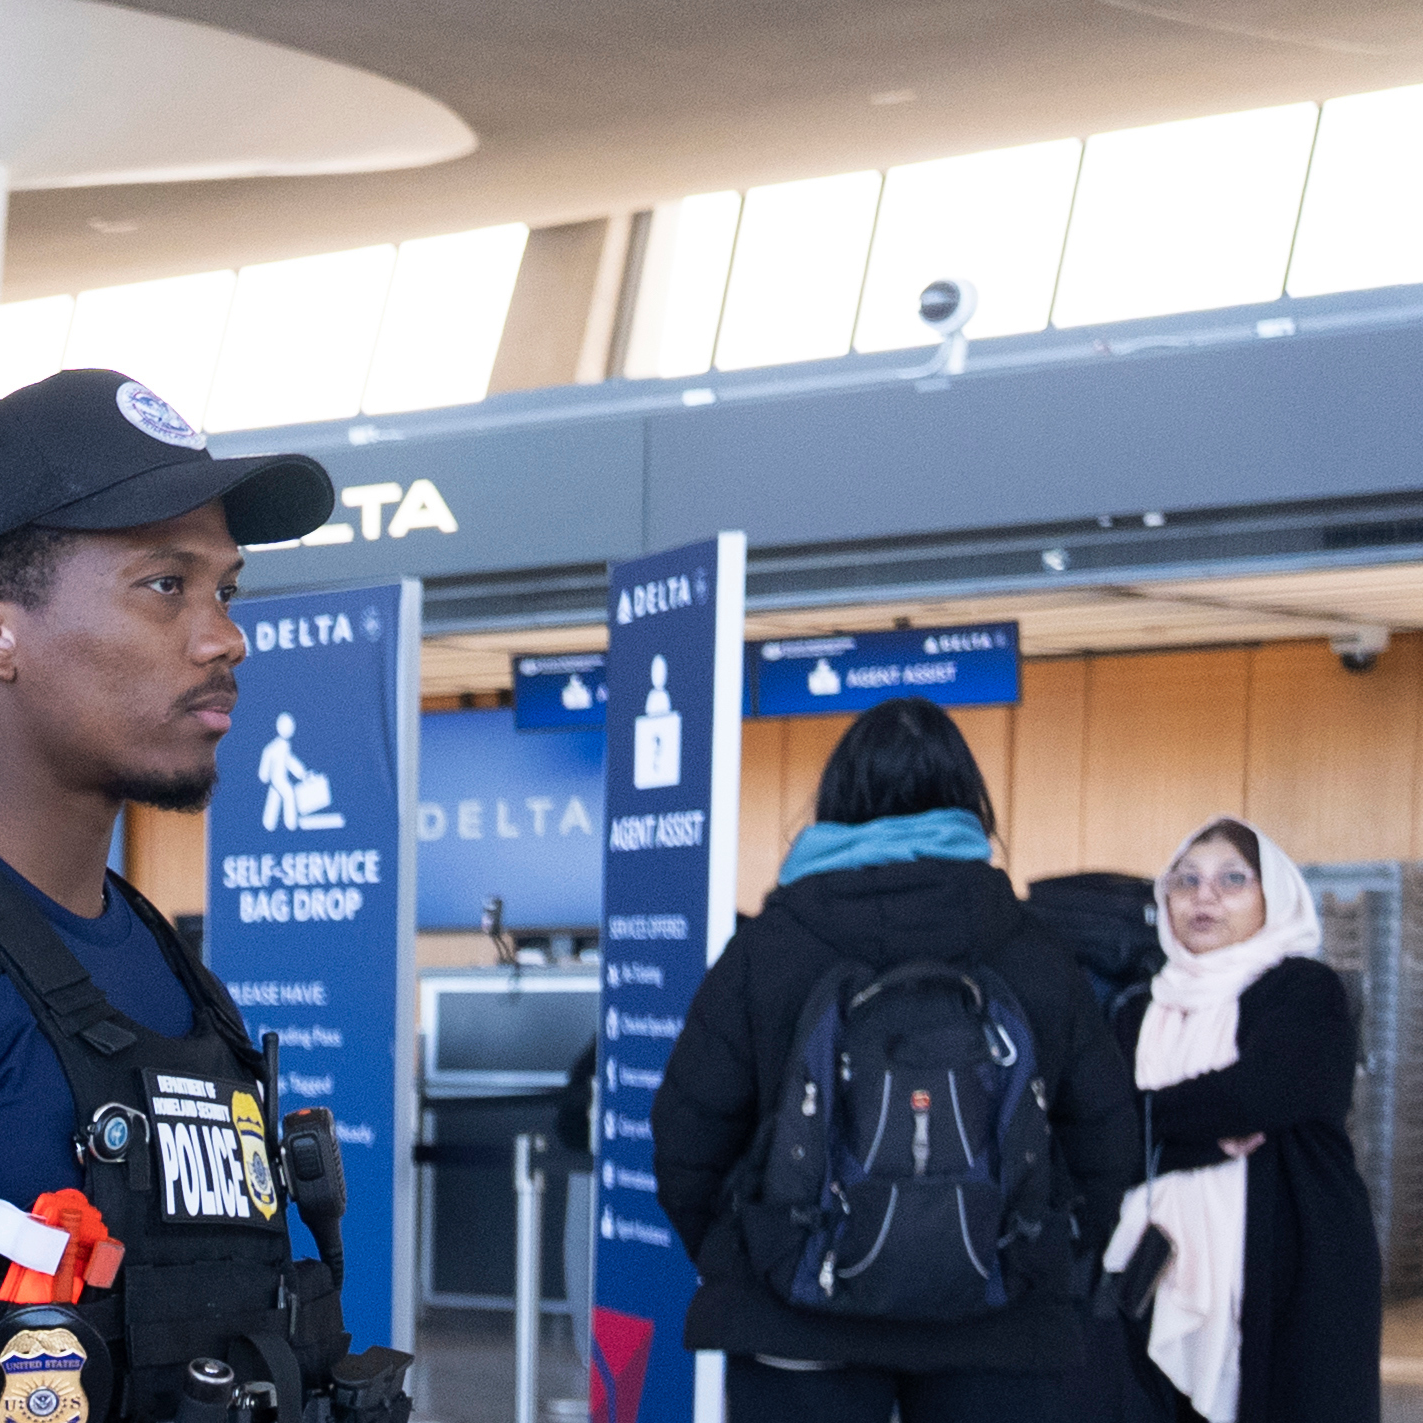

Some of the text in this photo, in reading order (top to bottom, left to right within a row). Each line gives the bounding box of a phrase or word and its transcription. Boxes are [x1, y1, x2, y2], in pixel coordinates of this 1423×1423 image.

[634, 574, 692, 618] DELTA
[256, 613, 353, 651] DELTA
[417, 796, 592, 841] DELTA
[609, 809, 705, 852] AGENT ASSIST
[223, 850, 380, 888] SELF-SERVICE
[240, 887, 362, 922] BAG DROP
[157, 1122, 251, 1218] POLICE
[6, 1360, 80, 1370] UNITED STATES
